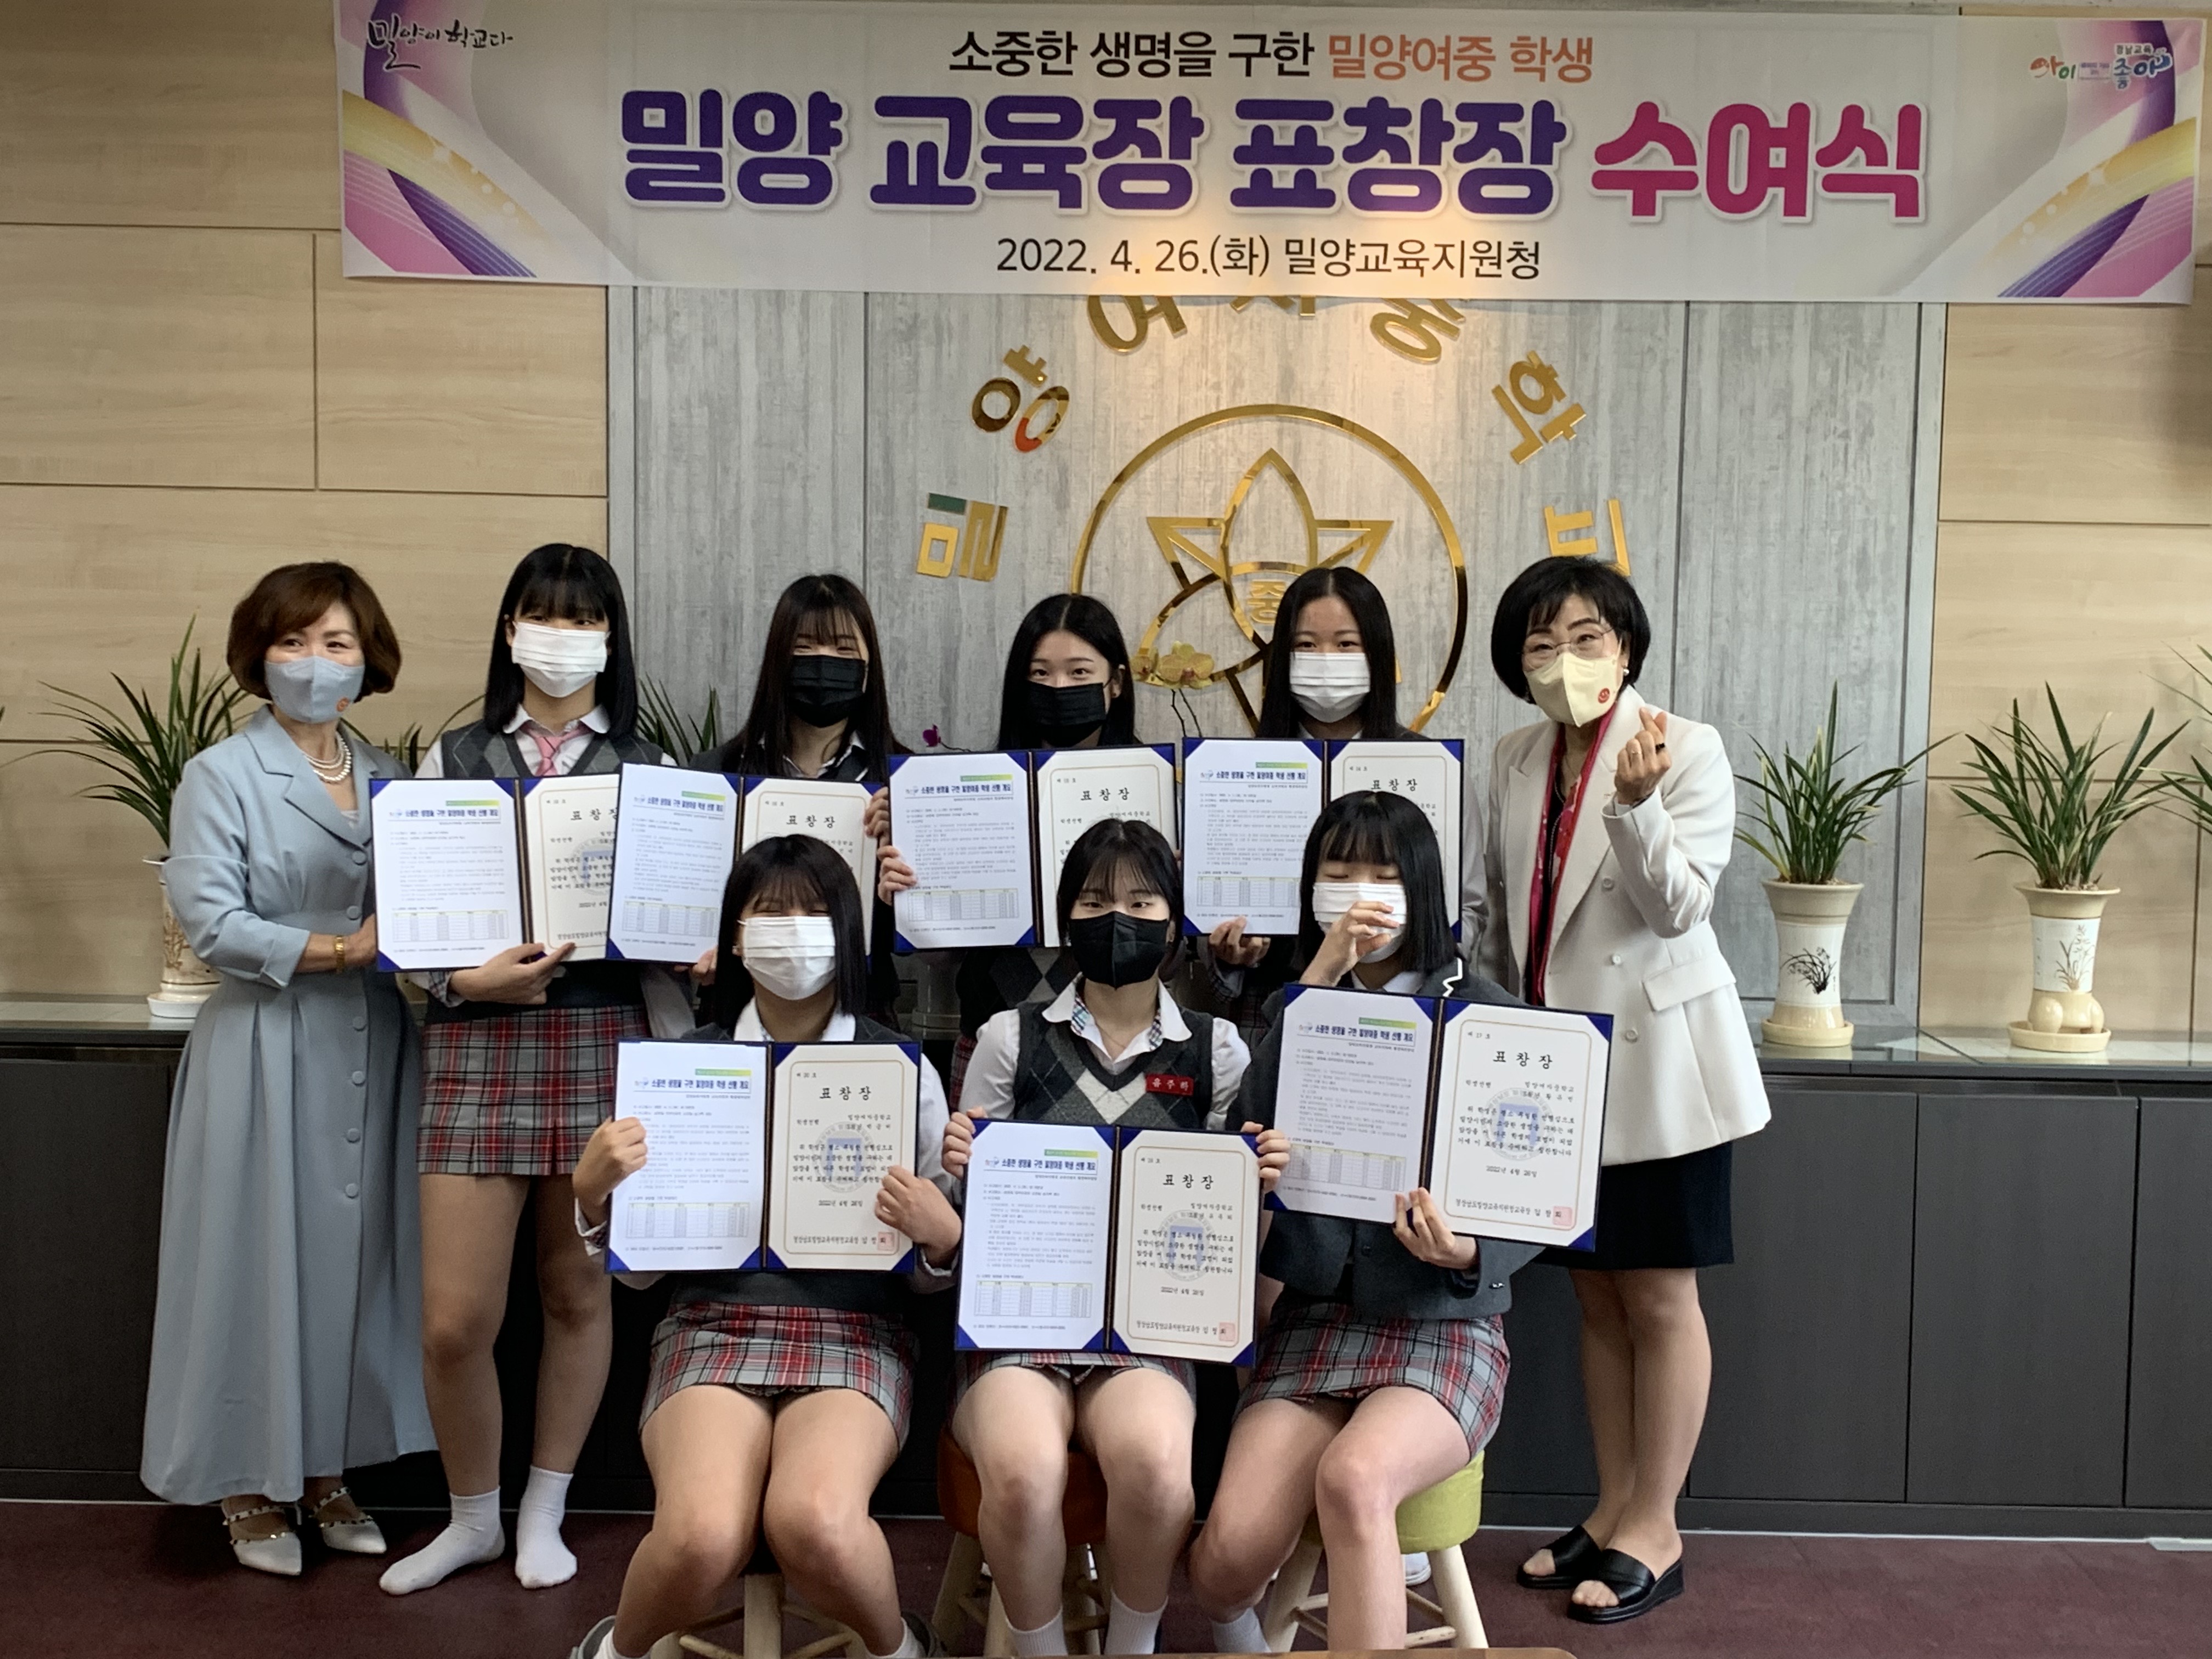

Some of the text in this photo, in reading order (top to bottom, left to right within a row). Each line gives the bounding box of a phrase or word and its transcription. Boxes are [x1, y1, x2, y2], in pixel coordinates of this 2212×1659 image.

[950, 31, 1594, 82] 소중한 생명을 구한 밀양여중 학생
[621, 88, 1922, 218] 밀양 교육장 표창장 수여식
[997, 235, 1540, 279] 2022. 4. 26.(화) 밀양교육지원청
[1247, 579, 1285, 624] 중
[1371, 778, 1417, 791] 표창장
[1081, 788, 1129, 801] 표창장
[786, 815, 835, 828] 표창장
[1493, 1051, 1553, 1069] 표창장
[820, 1086, 871, 1100] 표창장
[1163, 1174, 1214, 1189] 표창장
